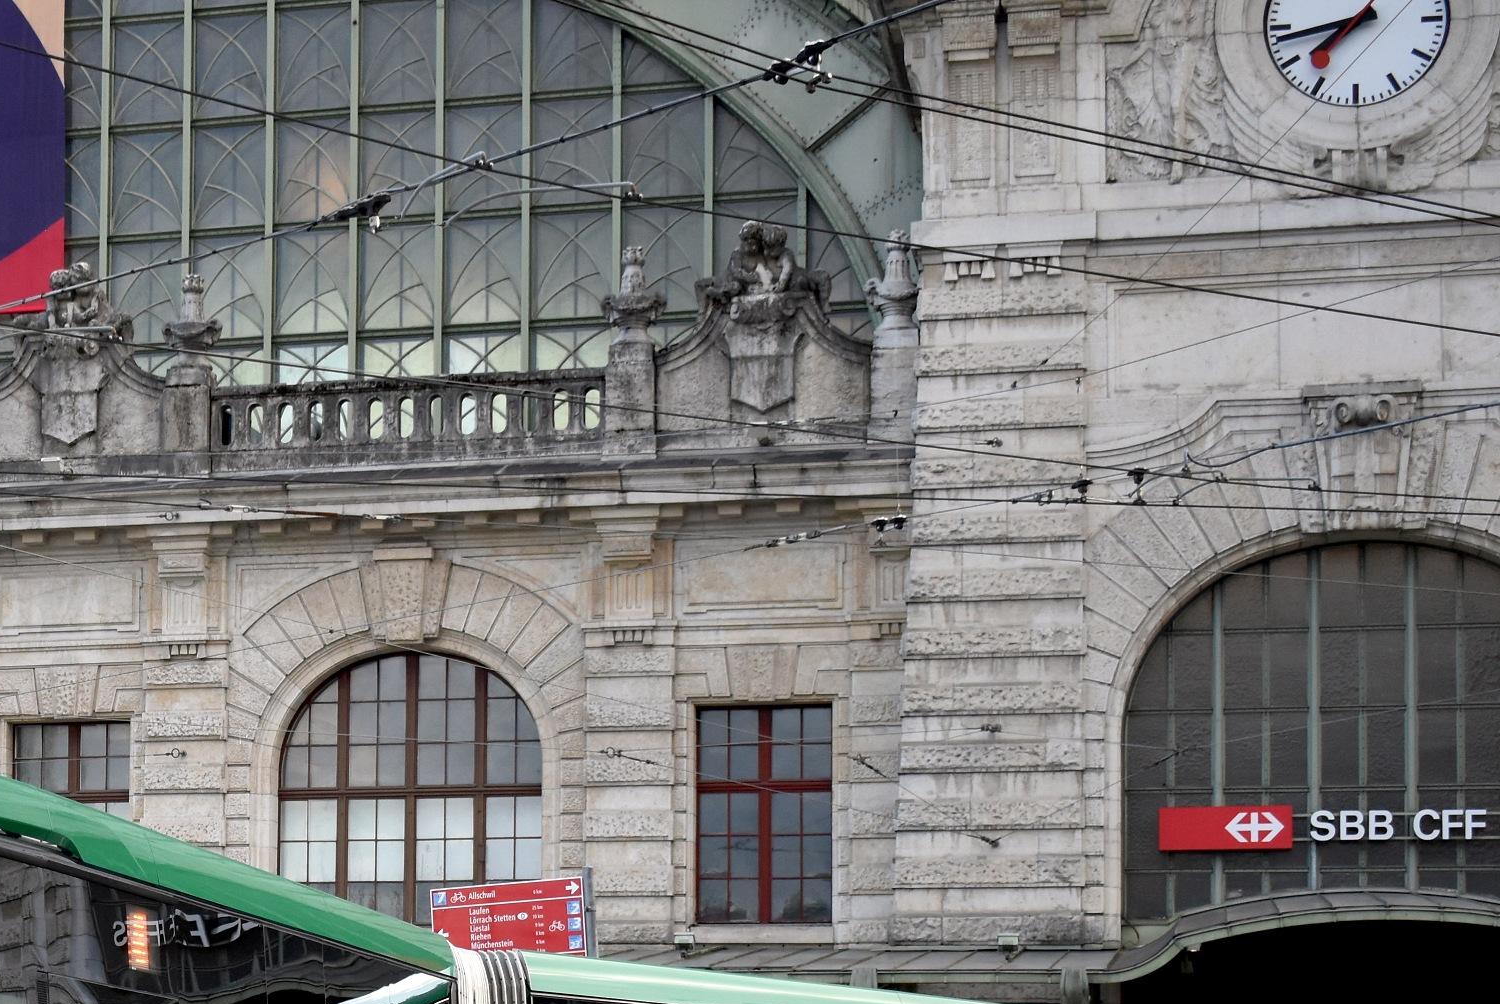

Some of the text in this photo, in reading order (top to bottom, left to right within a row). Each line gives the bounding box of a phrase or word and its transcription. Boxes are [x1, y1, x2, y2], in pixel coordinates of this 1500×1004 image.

[1309, 808, 1488, 842] SBB CFF
[468, 890, 496, 900] Allschwil
[468, 907, 490, 915] Laufen
[469, 915, 492, 924] Lörrach
[493, 914, 516, 922] Stetten
[470, 923, 490, 932] Liestal
[470, 932, 491, 941] Riehen
[471, 939, 514, 949] Münchenstein
